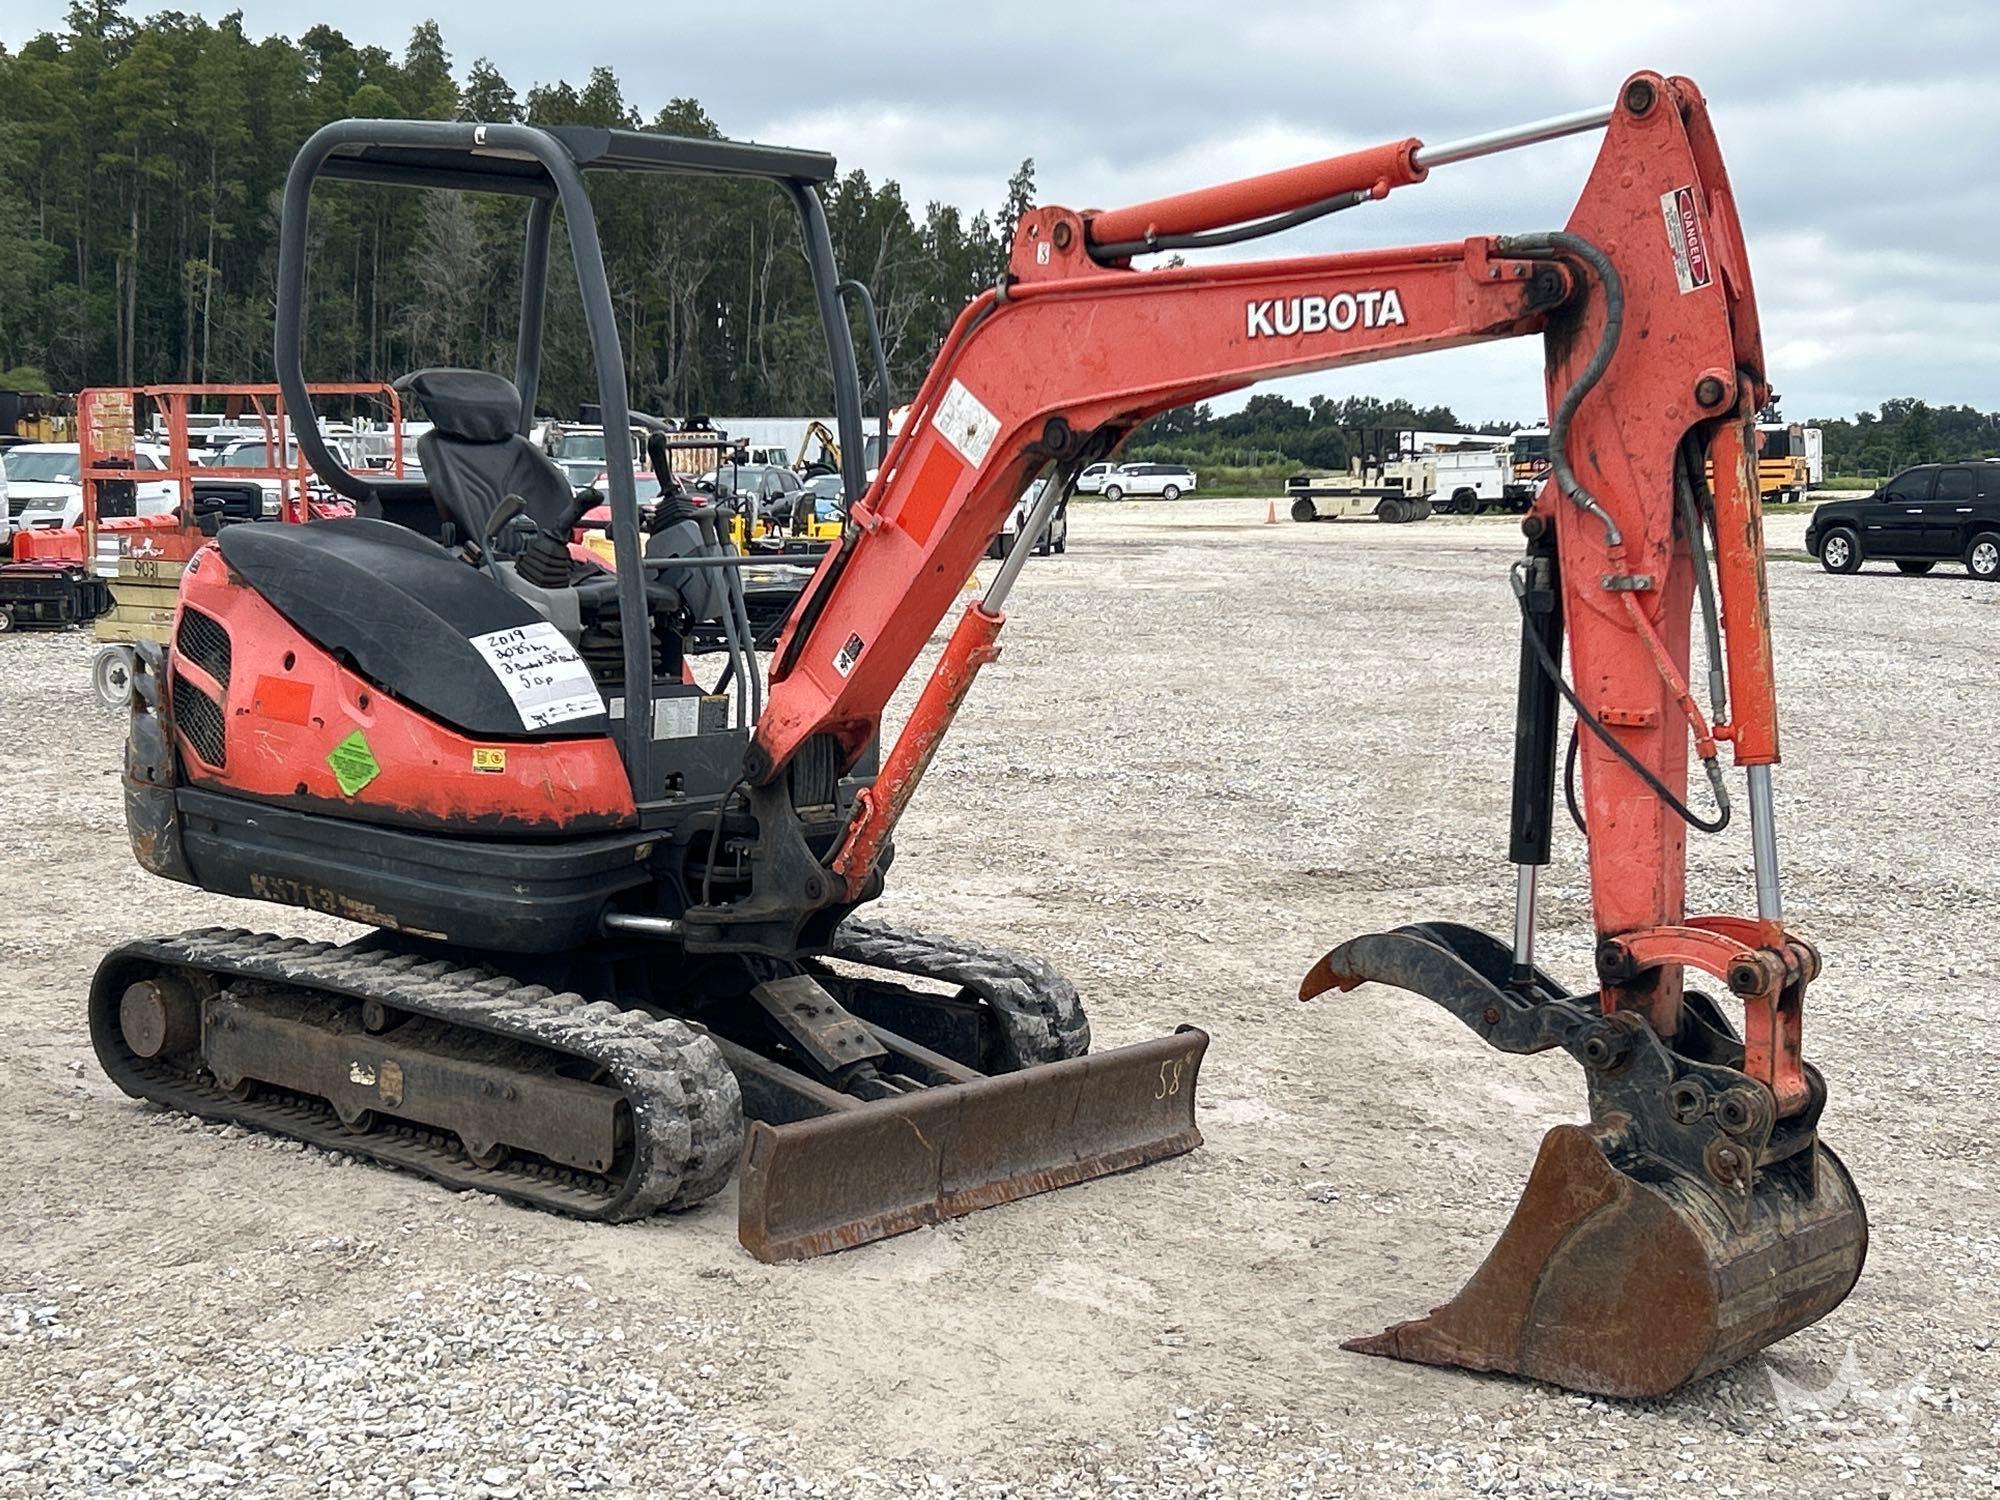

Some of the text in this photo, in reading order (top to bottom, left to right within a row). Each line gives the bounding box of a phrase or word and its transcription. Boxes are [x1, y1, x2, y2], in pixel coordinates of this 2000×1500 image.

[1683, 210, 1702, 265] DANGER
[1247, 289, 1405, 338] KUBOTA
[134, 559, 159, 579] 9031
[487, 629, 526, 647] 2019
